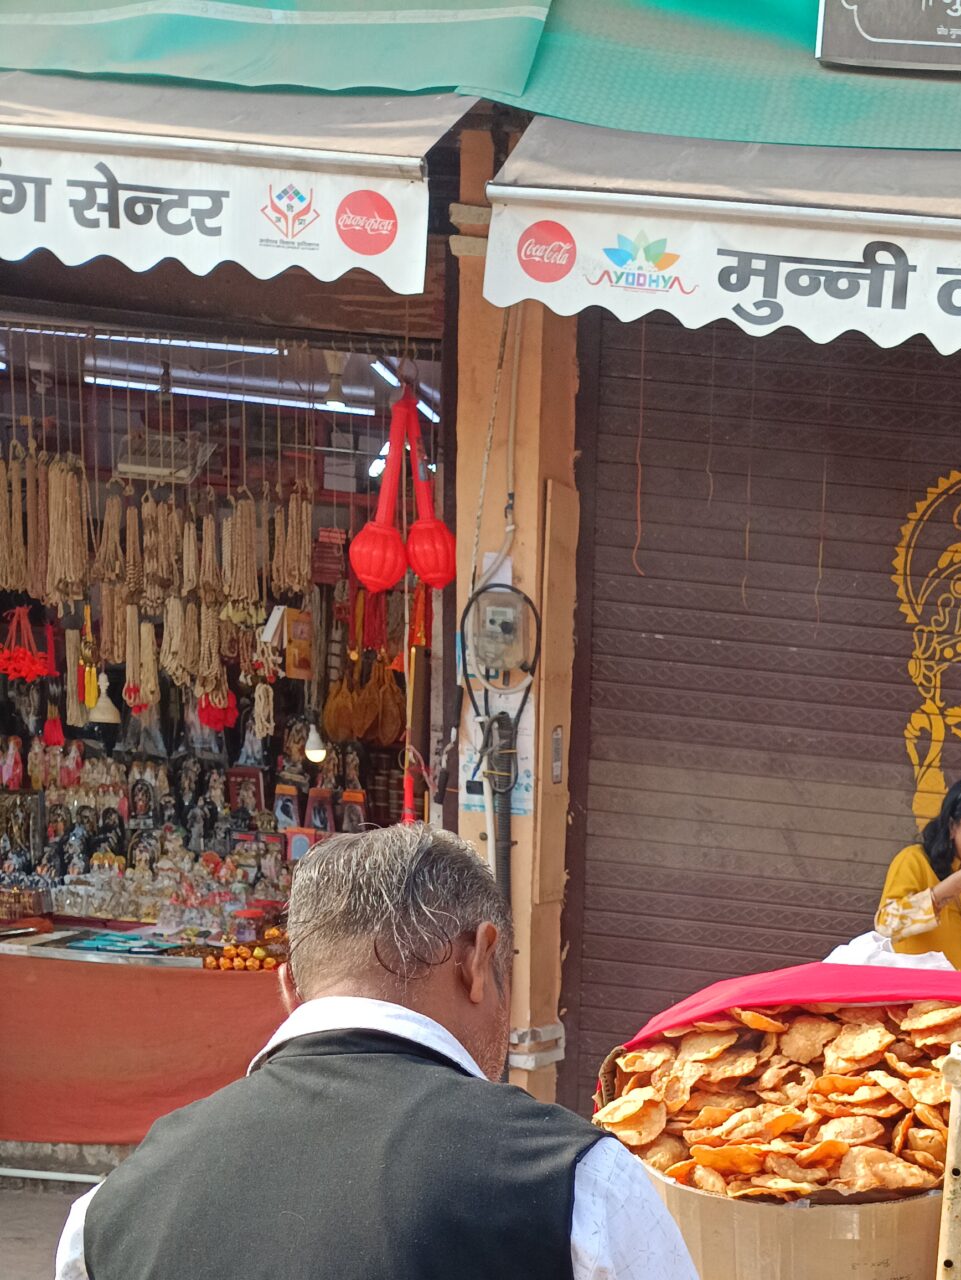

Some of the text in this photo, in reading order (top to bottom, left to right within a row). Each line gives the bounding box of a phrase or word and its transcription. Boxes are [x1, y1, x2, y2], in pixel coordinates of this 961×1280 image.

[67, 161, 230, 237] सेन्टर
[586, 270, 698, 295] AYODHYA
[716, 240, 918, 326] मुन्नी
